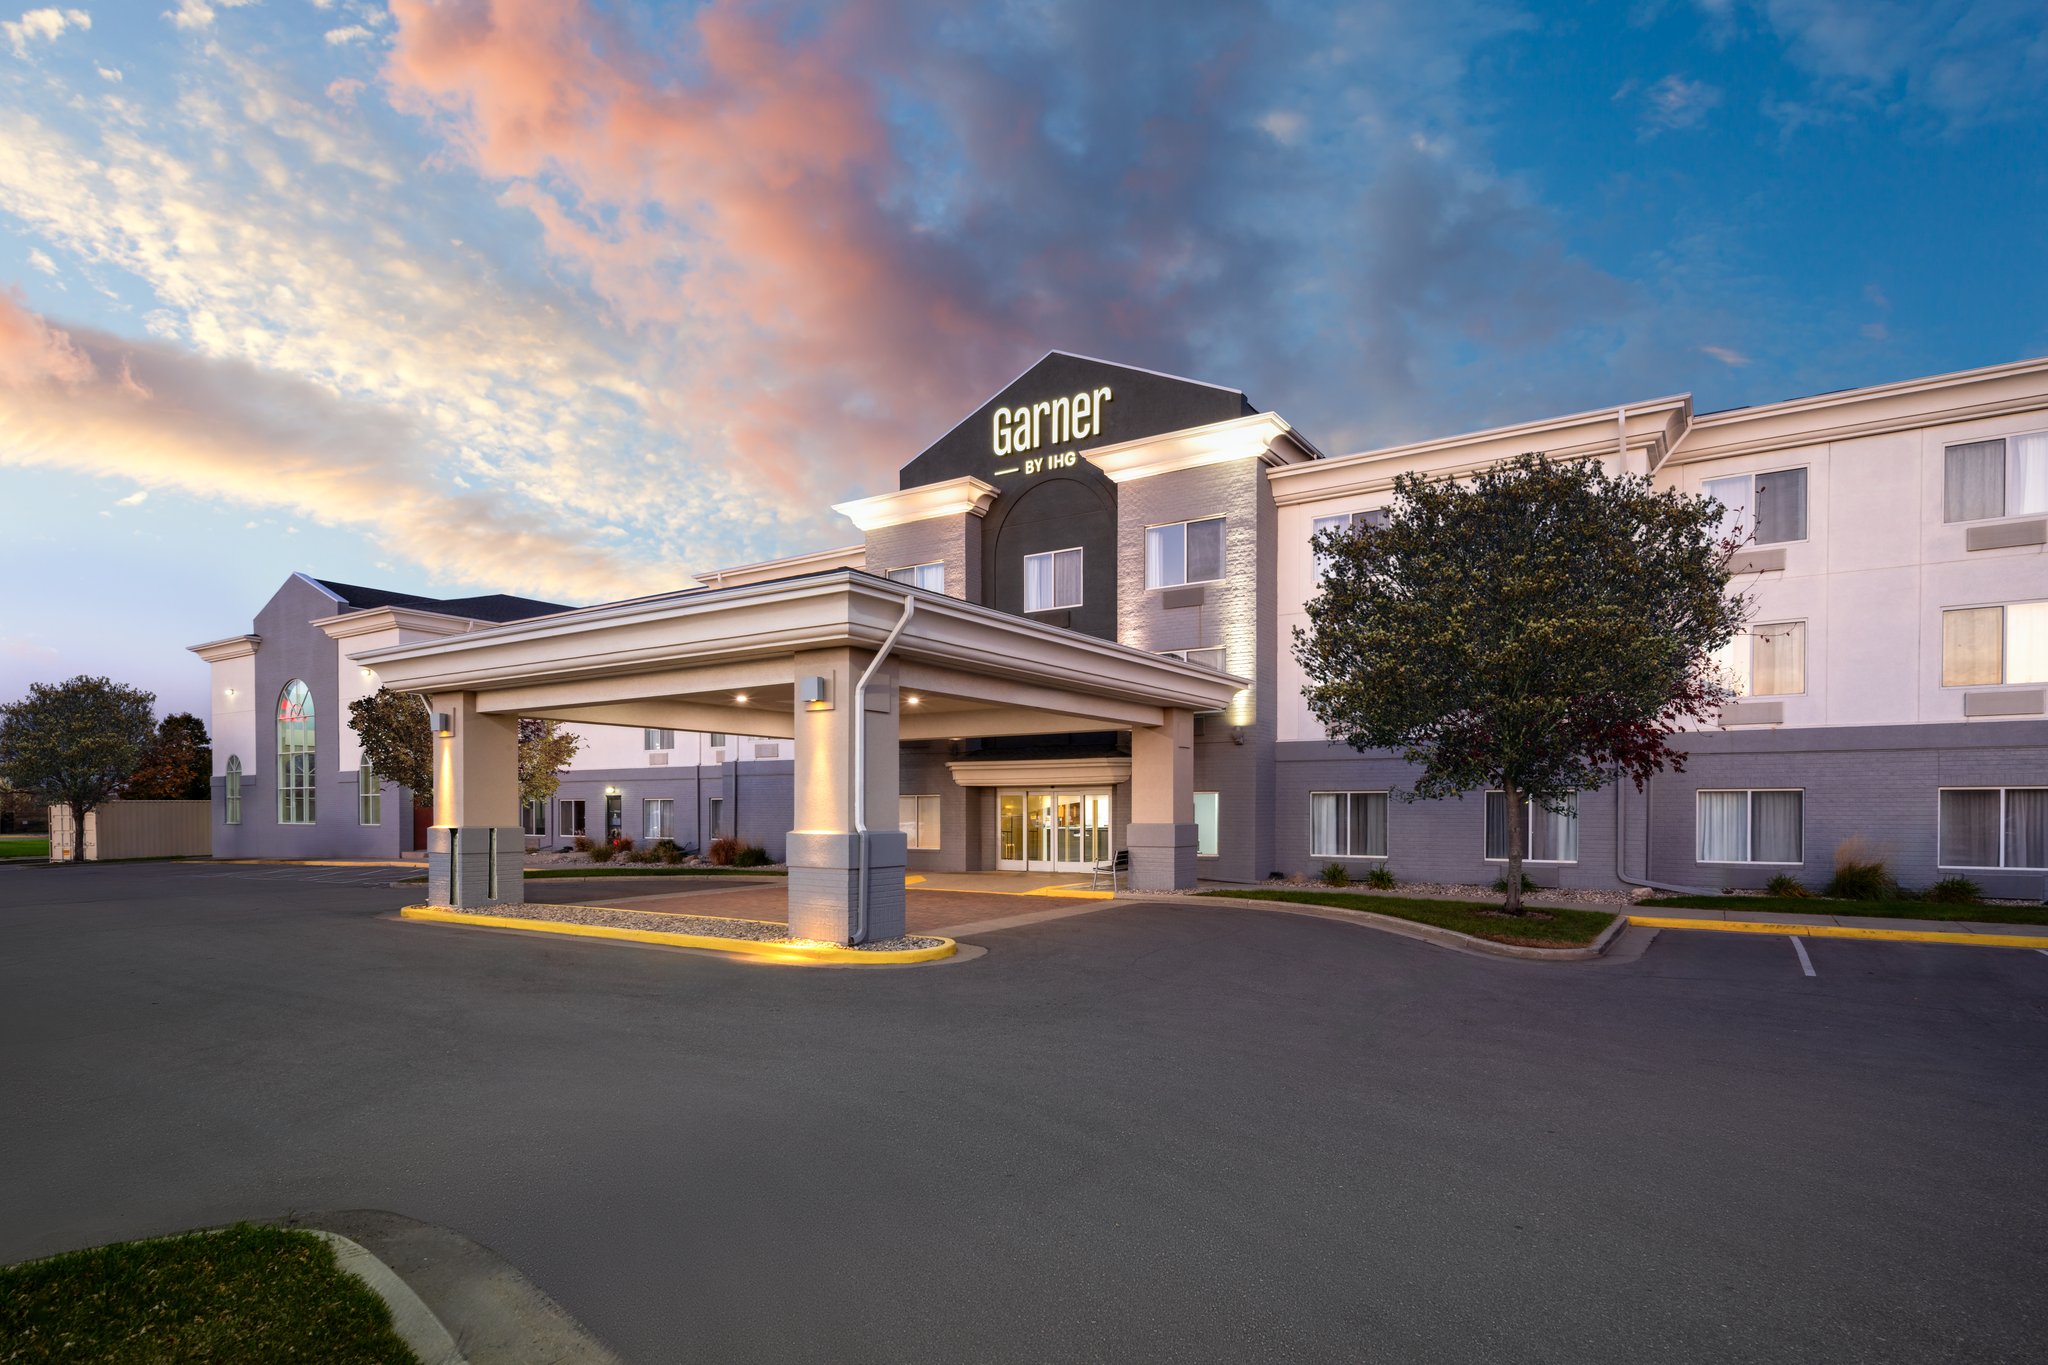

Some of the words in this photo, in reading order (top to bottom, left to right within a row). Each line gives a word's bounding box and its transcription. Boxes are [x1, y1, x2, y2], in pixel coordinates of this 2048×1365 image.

[993, 386, 1112, 456] Garner
[1025, 457, 1043, 475] BY
[1048, 451, 1076, 470] IHG
